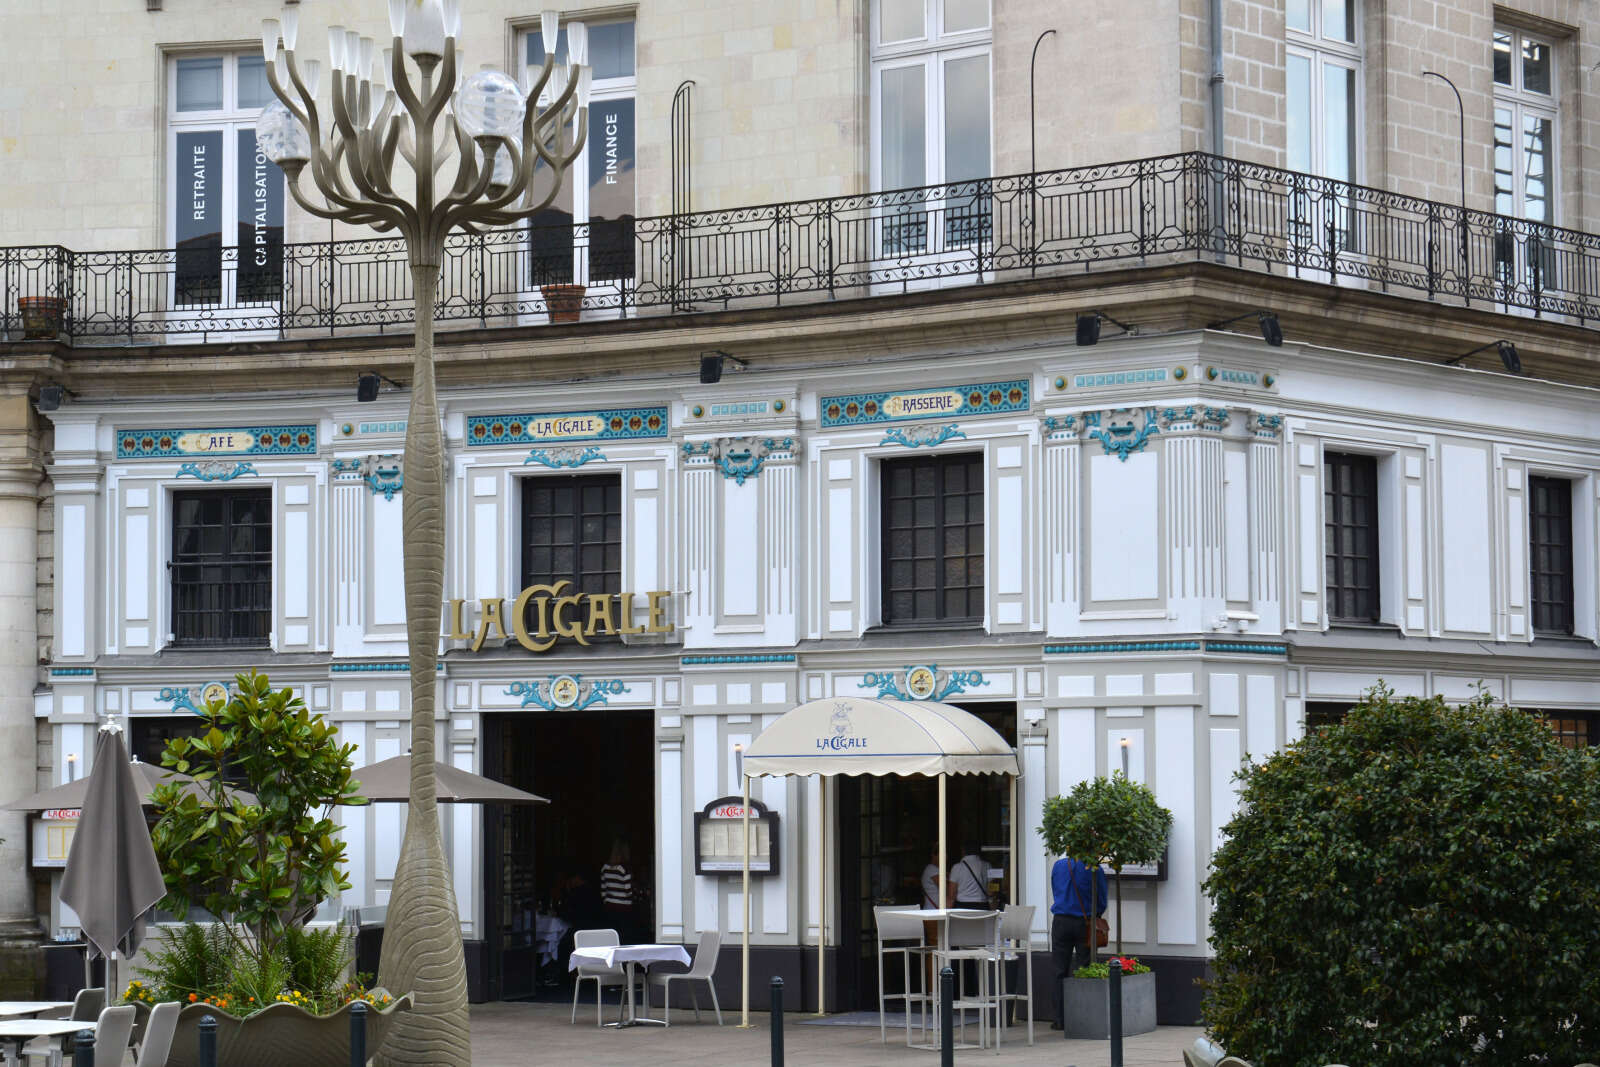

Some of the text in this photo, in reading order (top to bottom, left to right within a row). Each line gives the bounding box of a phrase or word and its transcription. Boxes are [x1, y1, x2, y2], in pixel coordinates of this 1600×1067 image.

[194, 145, 205, 220] RETRAITE
[606, 113, 617, 184] FINANCE
[255, 142, 267, 265] CAPITALISATION
